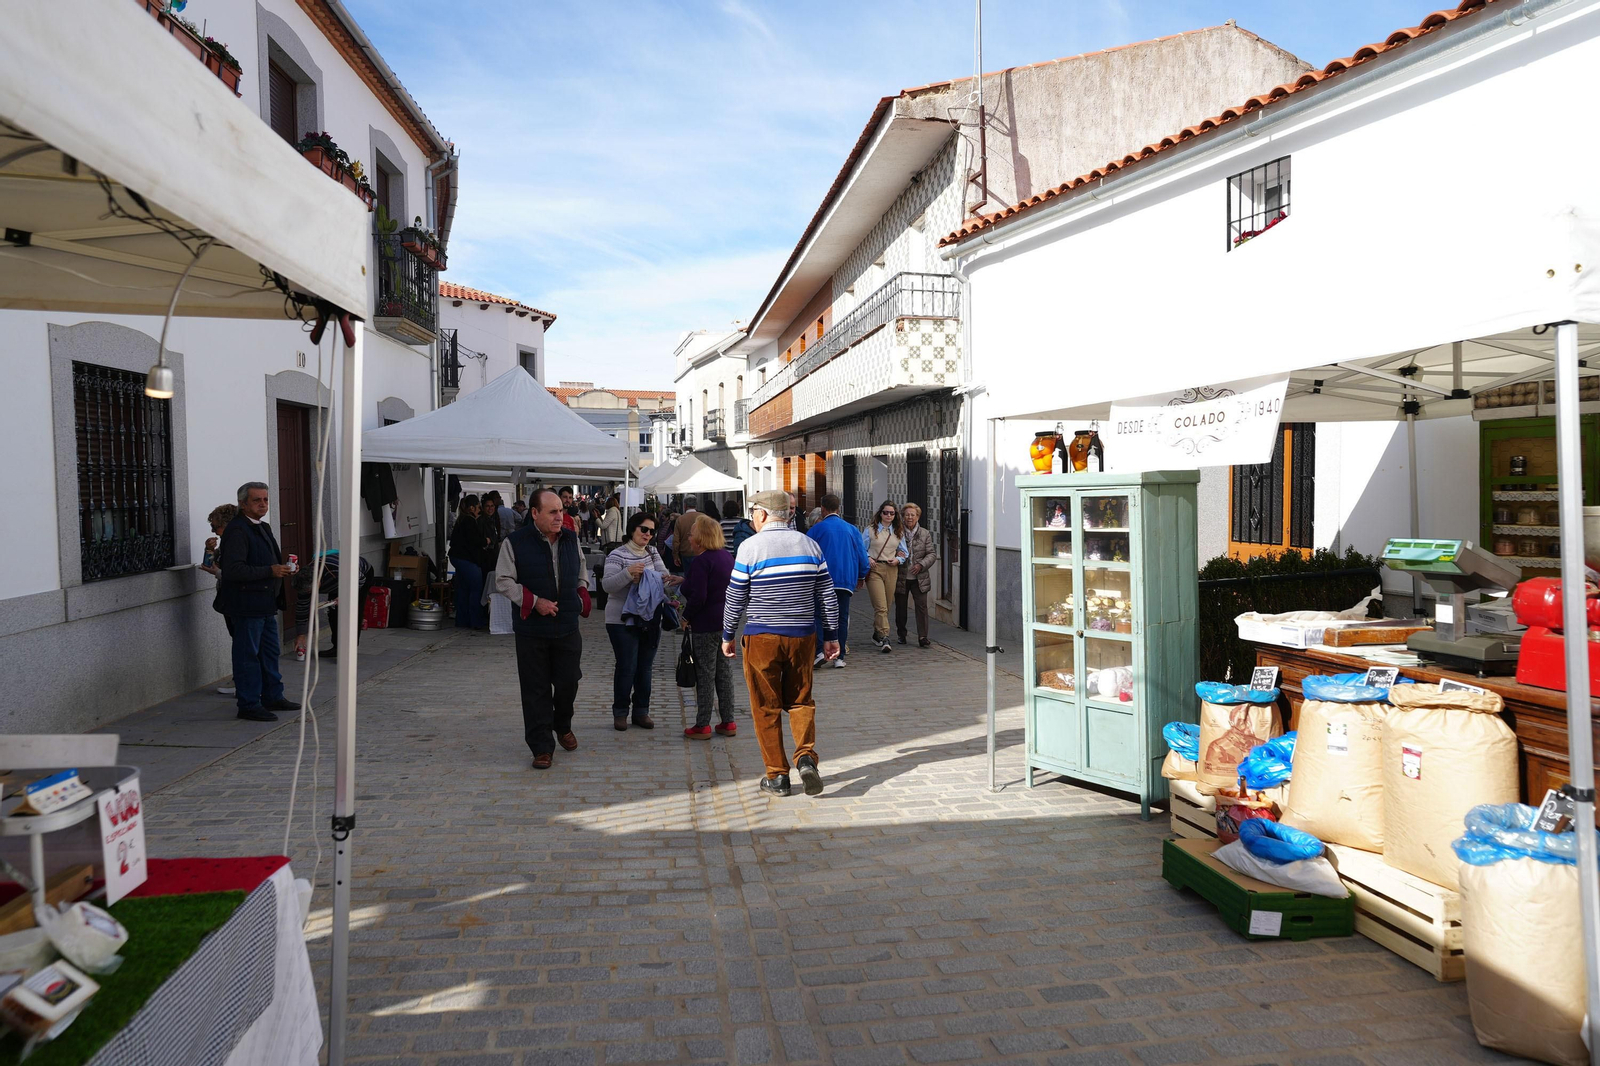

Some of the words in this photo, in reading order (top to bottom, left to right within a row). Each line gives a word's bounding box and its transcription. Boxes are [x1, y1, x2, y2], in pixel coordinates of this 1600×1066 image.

[298, 352, 306, 368] 10
[1117, 419, 1144, 435] DESDE
[1174, 411, 1226, 429] COLADO
[1254, 397, 1281, 417] 1940
